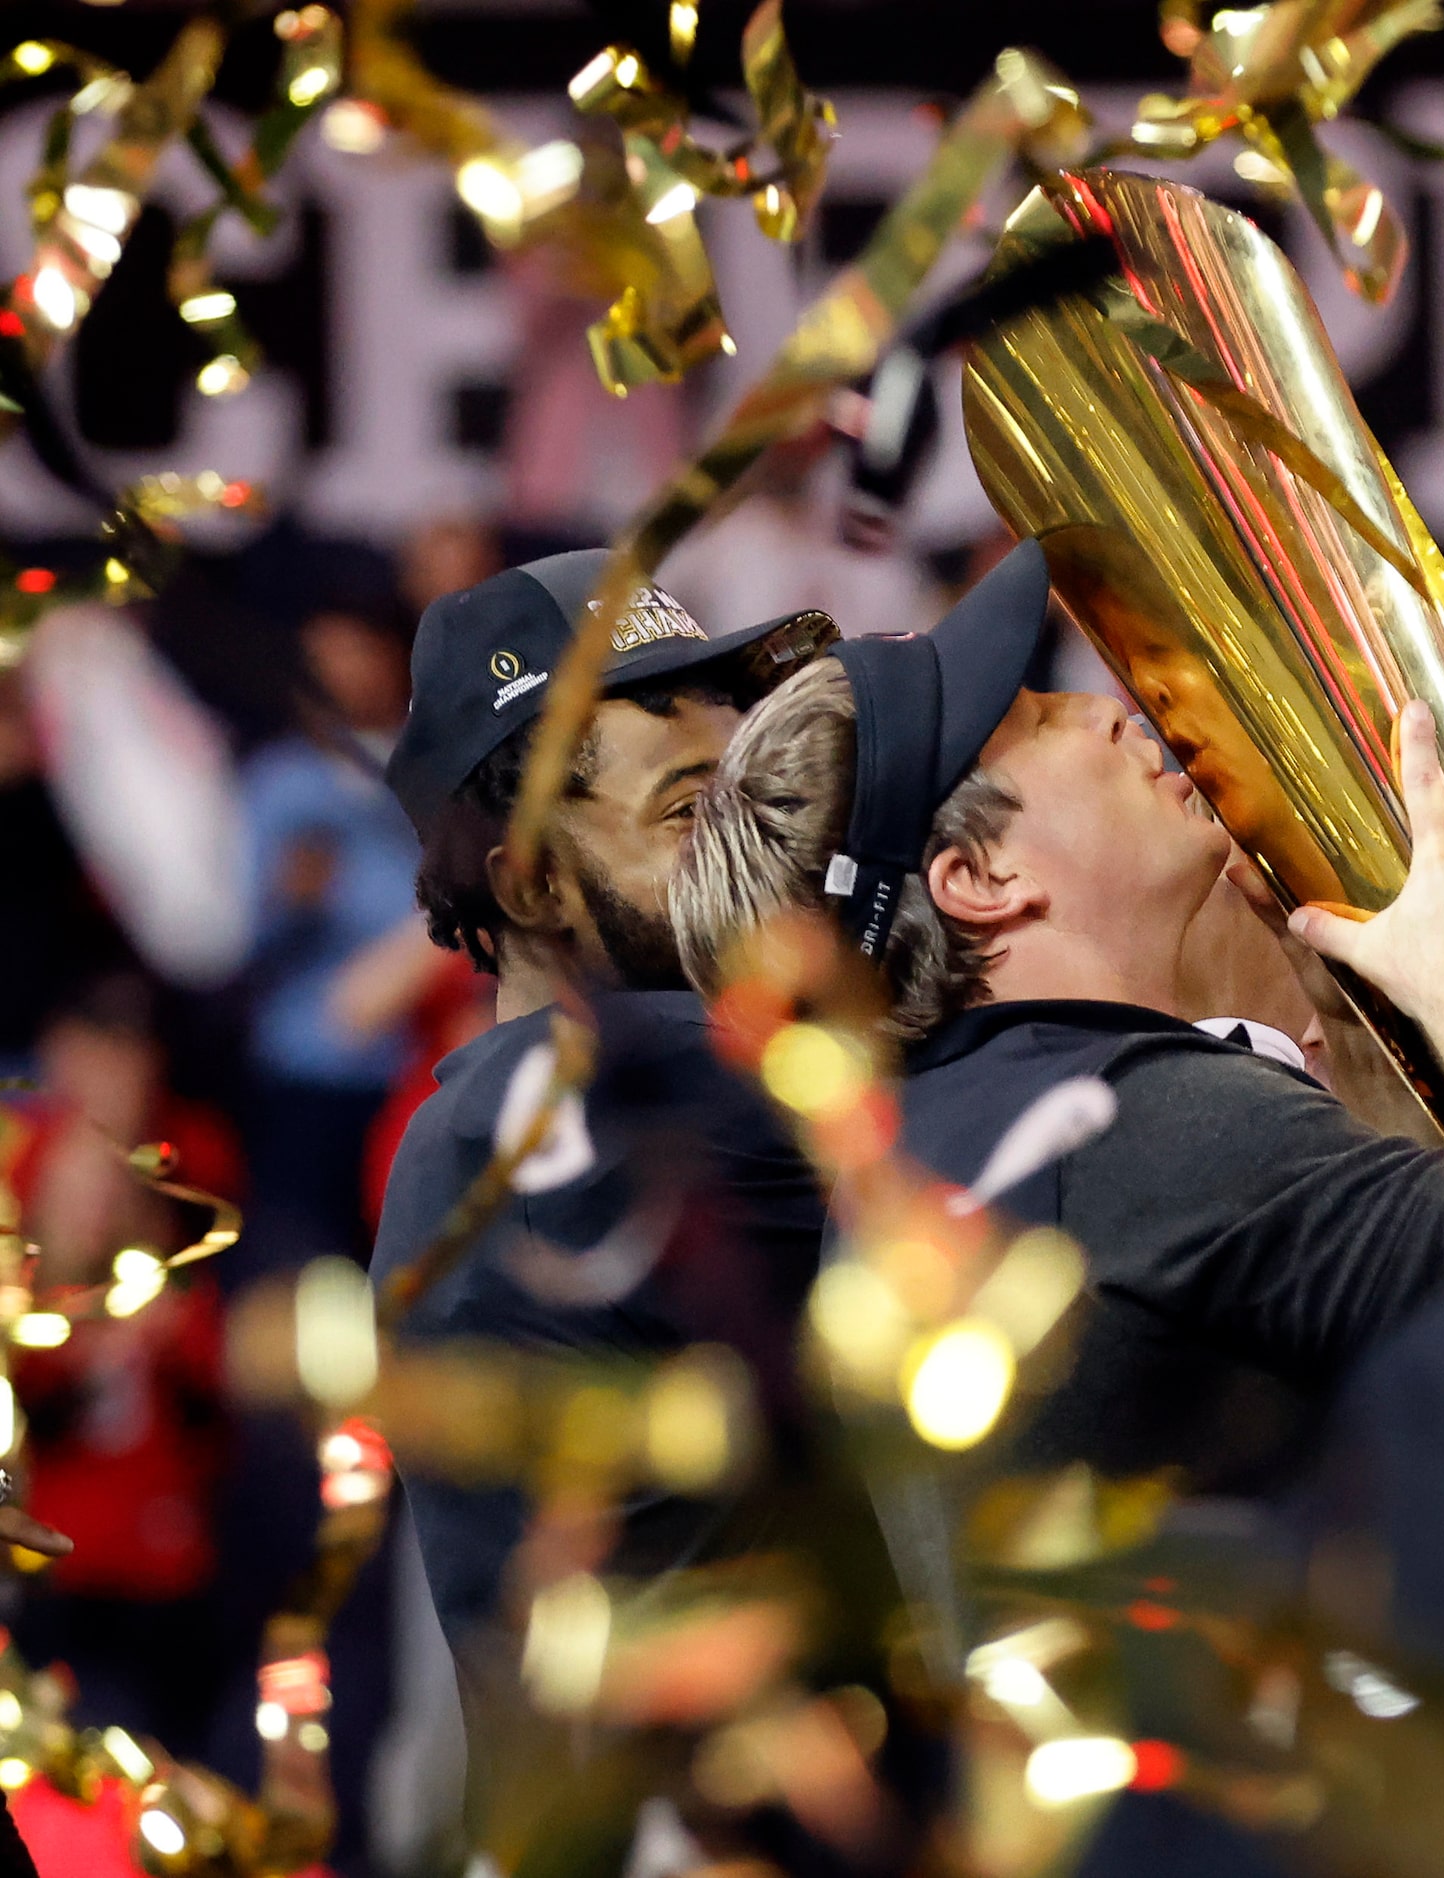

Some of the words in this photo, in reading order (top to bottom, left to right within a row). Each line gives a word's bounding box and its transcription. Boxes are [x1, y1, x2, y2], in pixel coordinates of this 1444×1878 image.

[493, 671, 549, 710] CHAMPIONSHIP
[497, 672, 534, 697] NATIONAL
[860, 881, 891, 956] DRI-FIT
